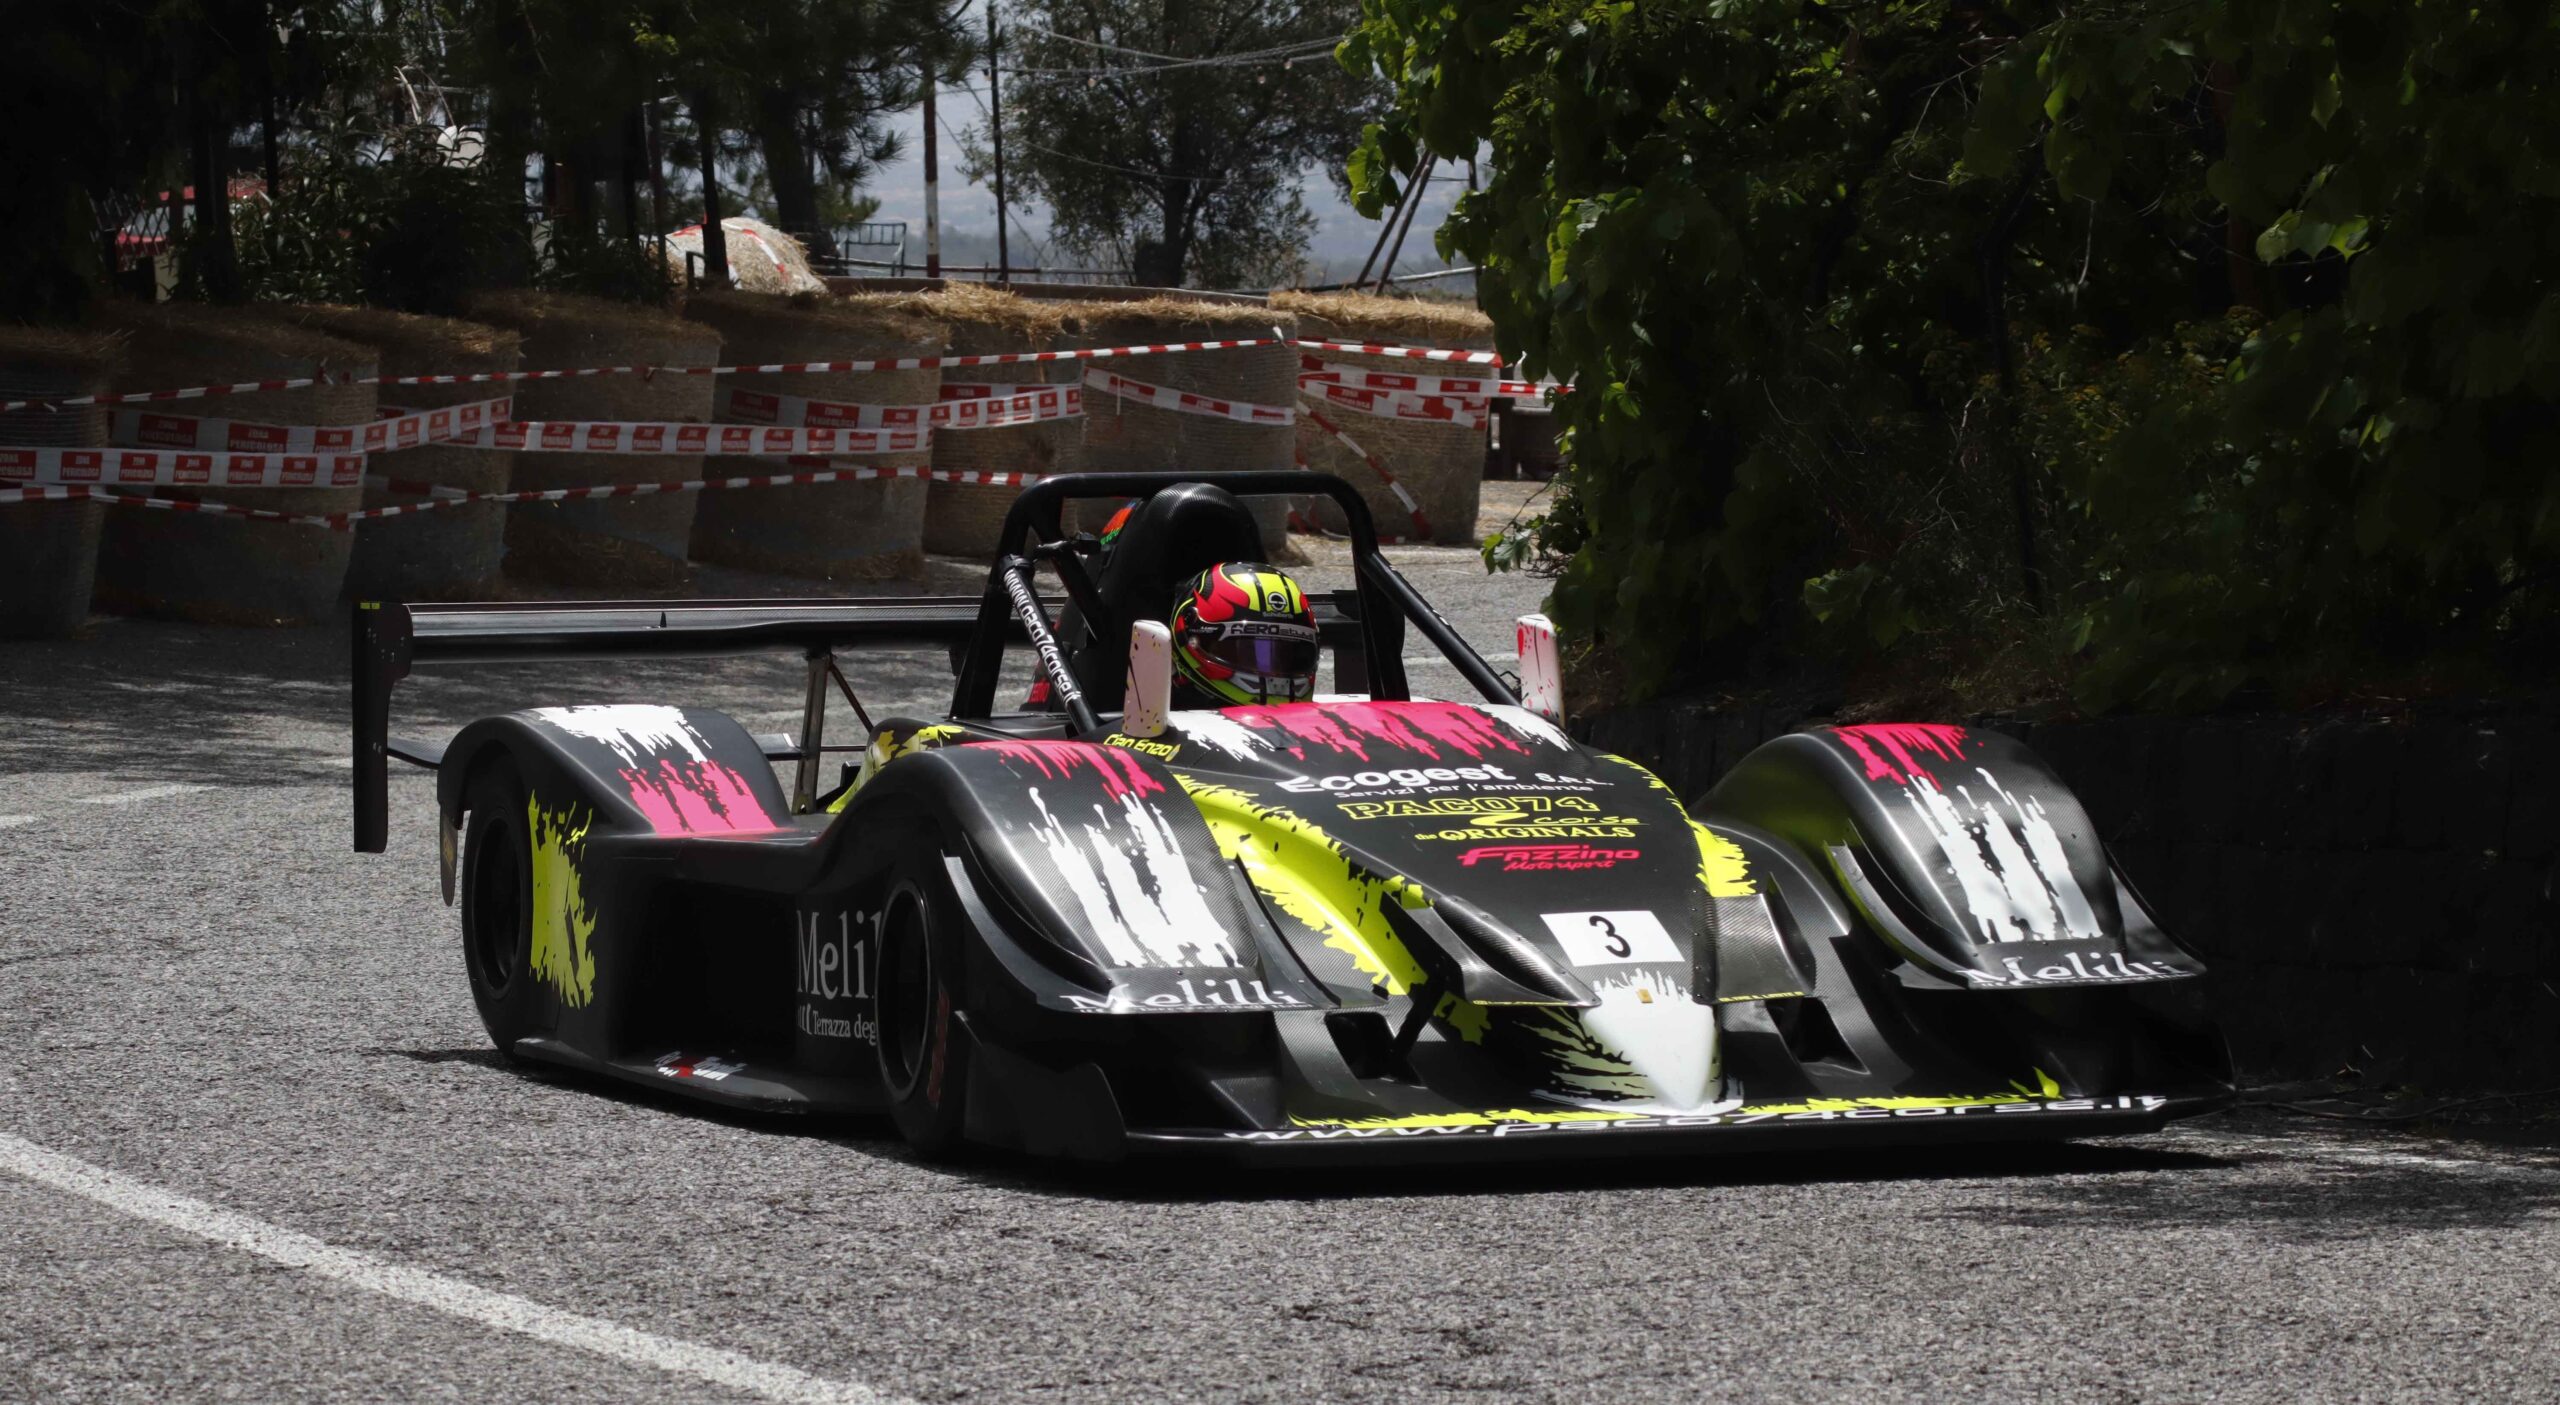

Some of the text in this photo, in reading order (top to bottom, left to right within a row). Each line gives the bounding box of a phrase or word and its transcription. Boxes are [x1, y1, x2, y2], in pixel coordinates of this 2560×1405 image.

[1003, 568, 1081, 707] www.paco74corse.it
[1133, 739, 1173, 757] Enzo
[1275, 763, 1517, 793] Ecogest
[1333, 782, 1594, 799] Servizi per l'ambiente
[1336, 796, 1600, 820] PACO74
[1533, 815, 1641, 825] corse
[1414, 826, 1636, 841] the ORIGINALS
[1503, 859, 1616, 872] Motorsport
[1588, 914, 1632, 959] 3
[1059, 977, 1306, 1009] Melilli
[812, 1010, 852, 1038] Terrazza
[1223, 1094, 2168, 1140] www.paco74corse.it
